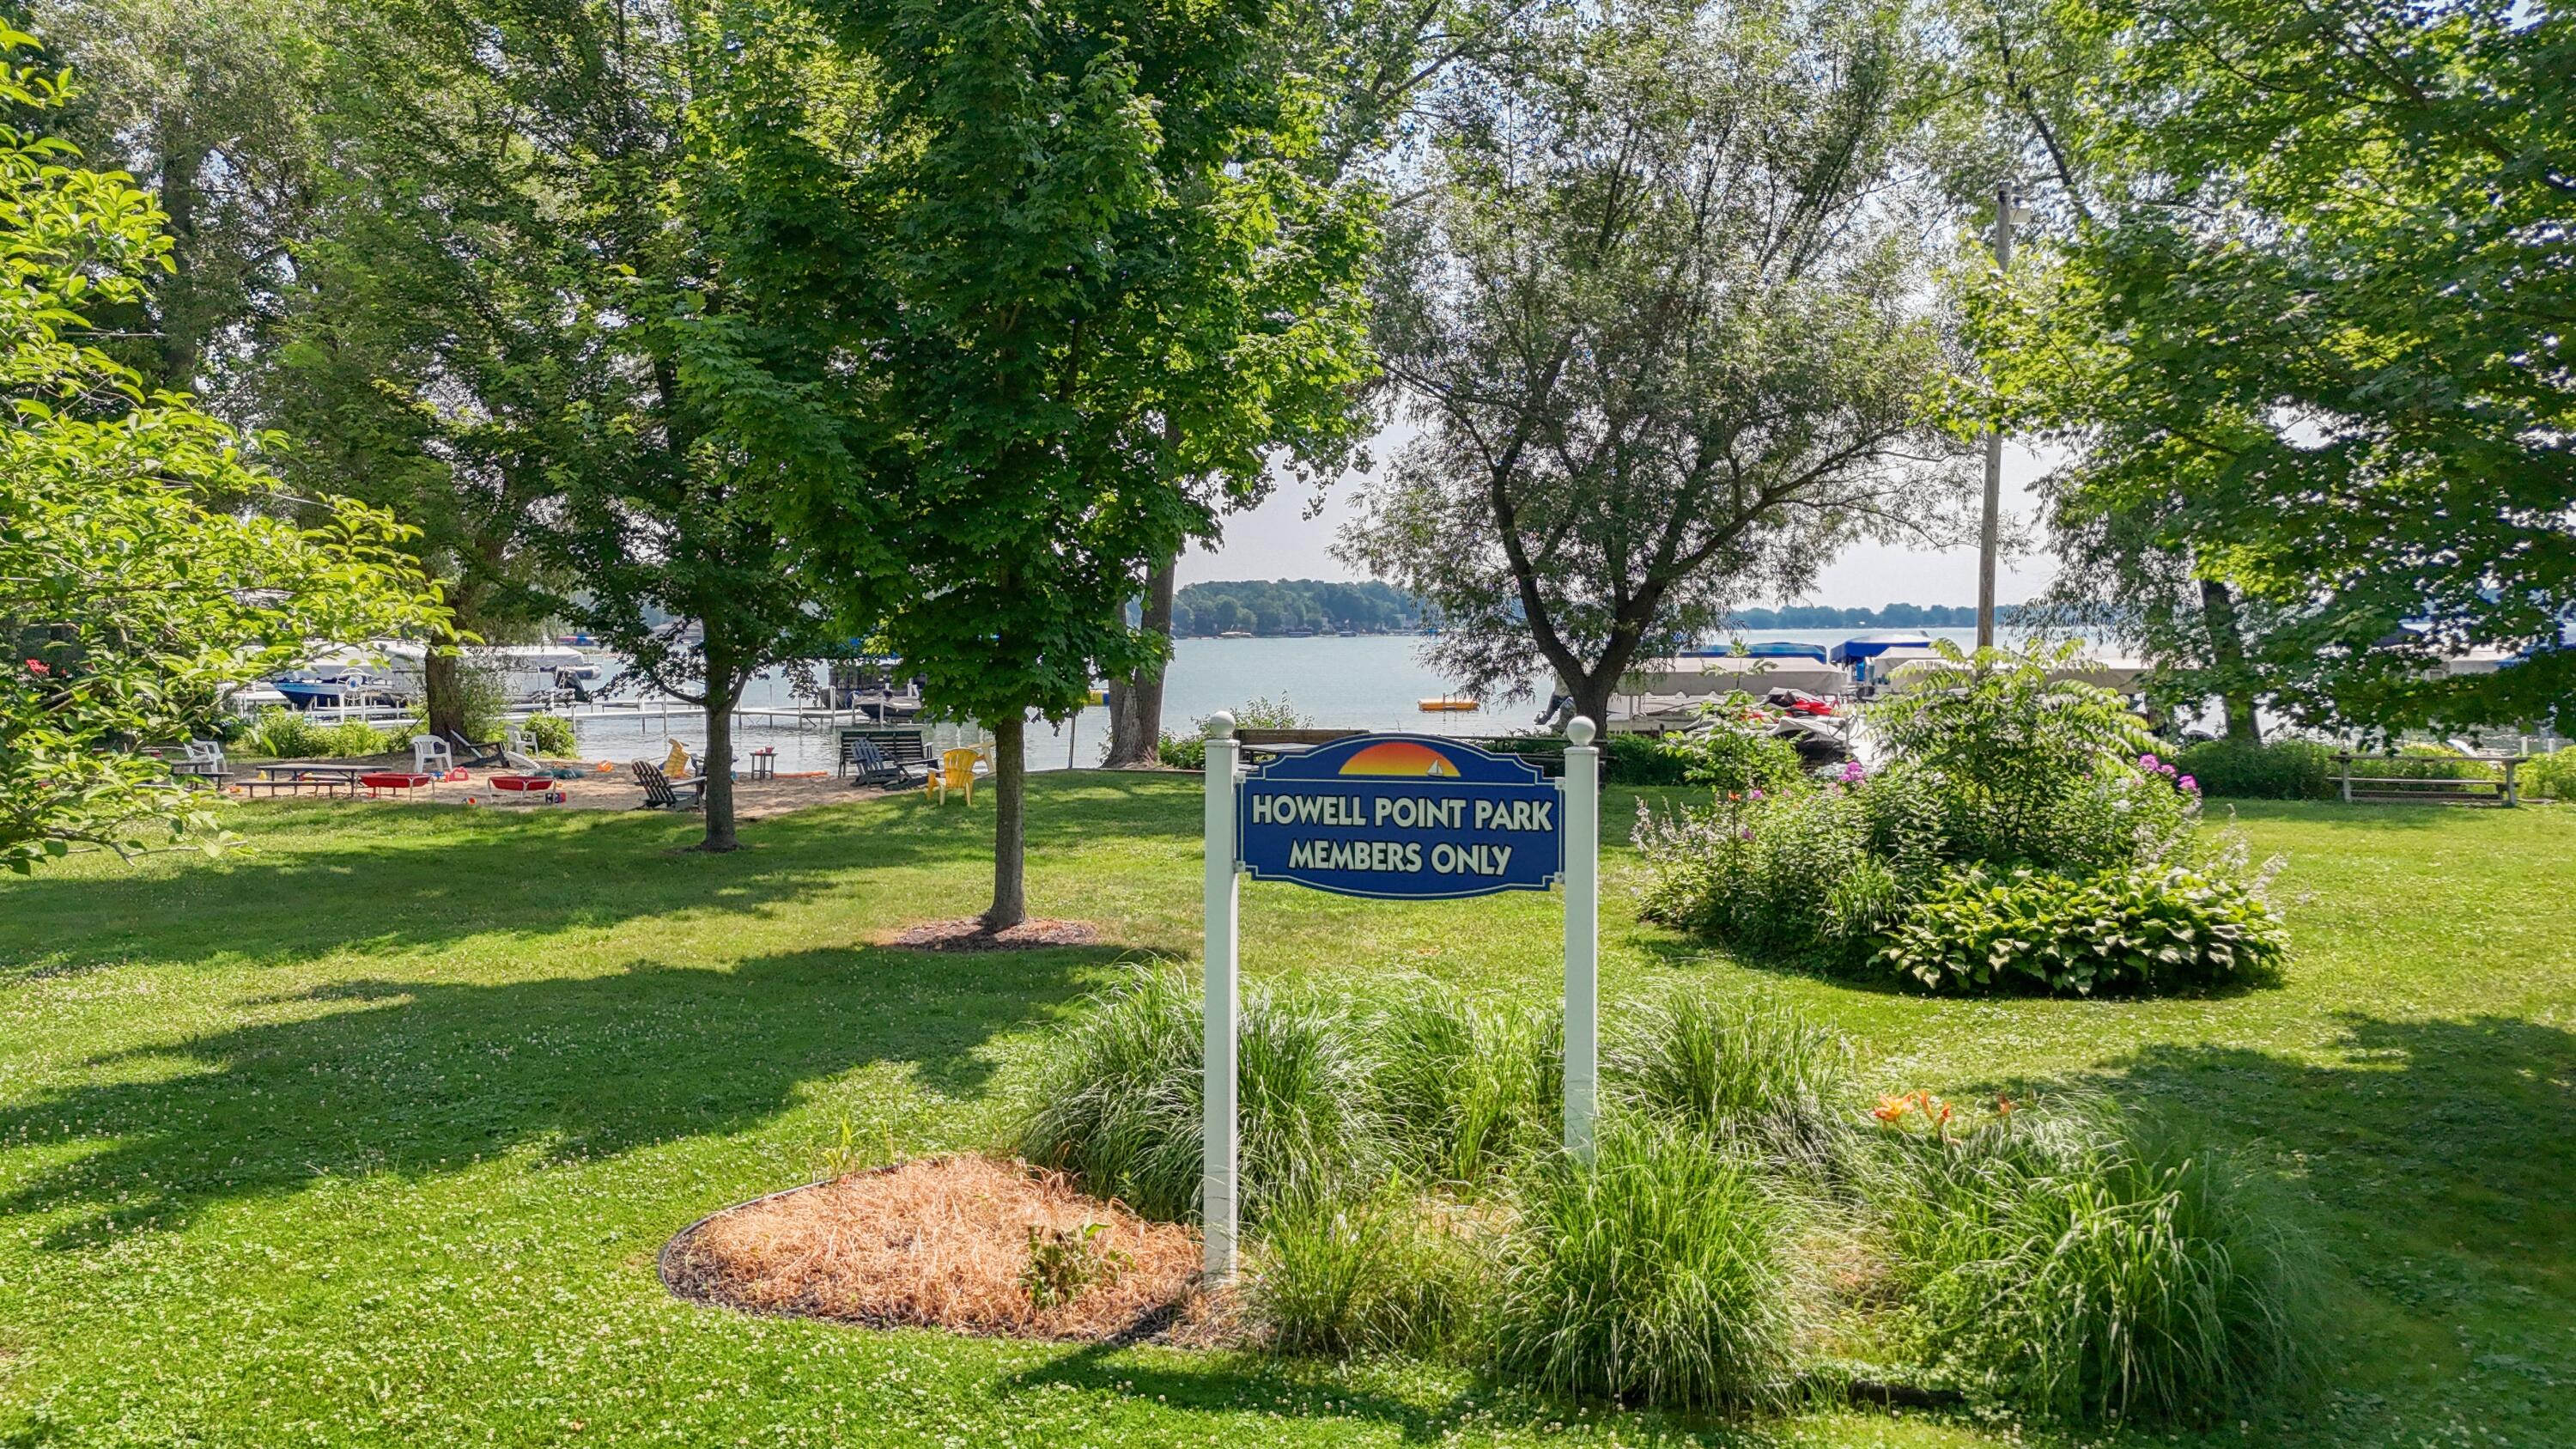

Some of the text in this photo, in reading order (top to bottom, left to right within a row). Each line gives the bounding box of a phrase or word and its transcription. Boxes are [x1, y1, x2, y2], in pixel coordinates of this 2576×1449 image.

[1252, 795, 1553, 831] HOWELL POINT PARK
[1288, 839, 1512, 876] MEMBERS ONLY
